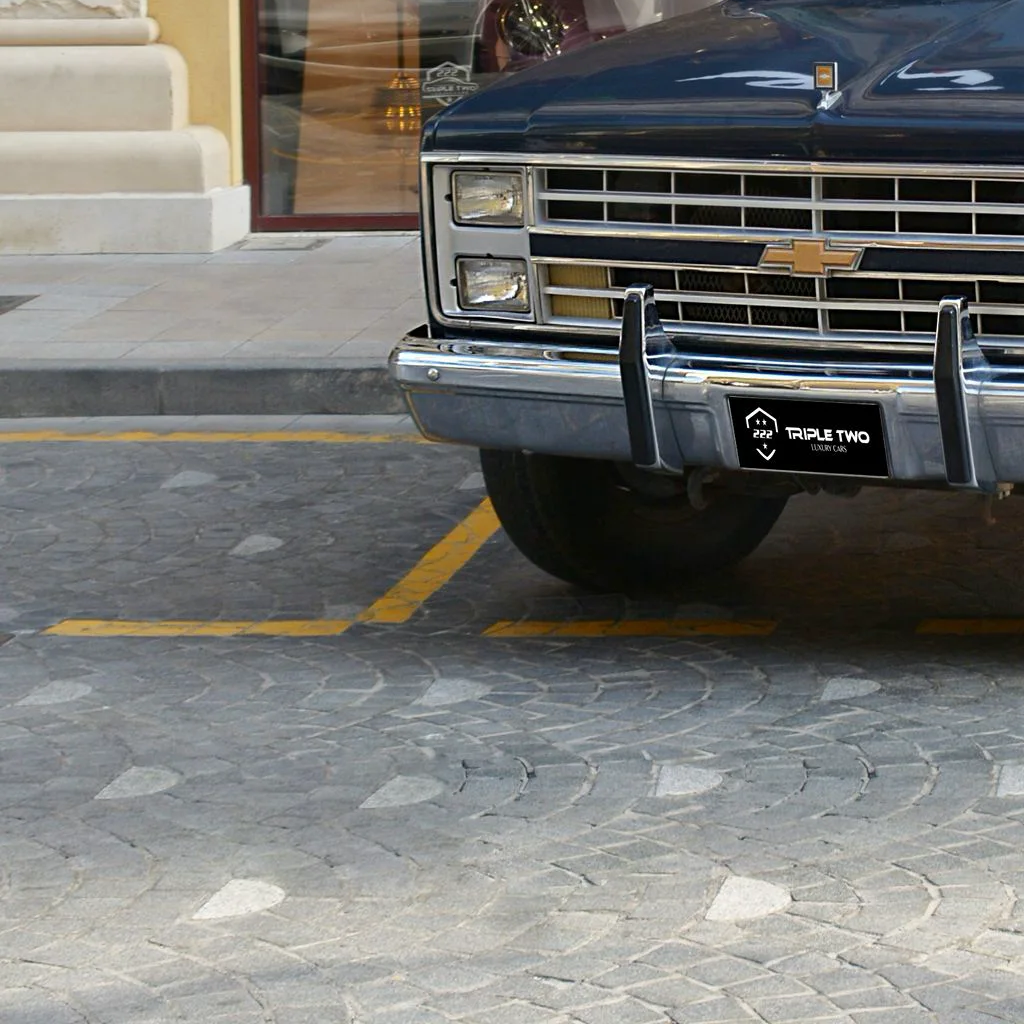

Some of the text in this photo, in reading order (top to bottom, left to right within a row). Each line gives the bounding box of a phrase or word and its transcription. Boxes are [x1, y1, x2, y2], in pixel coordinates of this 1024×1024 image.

[752, 428, 773, 439] 222
[785, 427, 871, 444] TRIPLE TWO
[810, 443, 848, 453] LUXURY CARS
